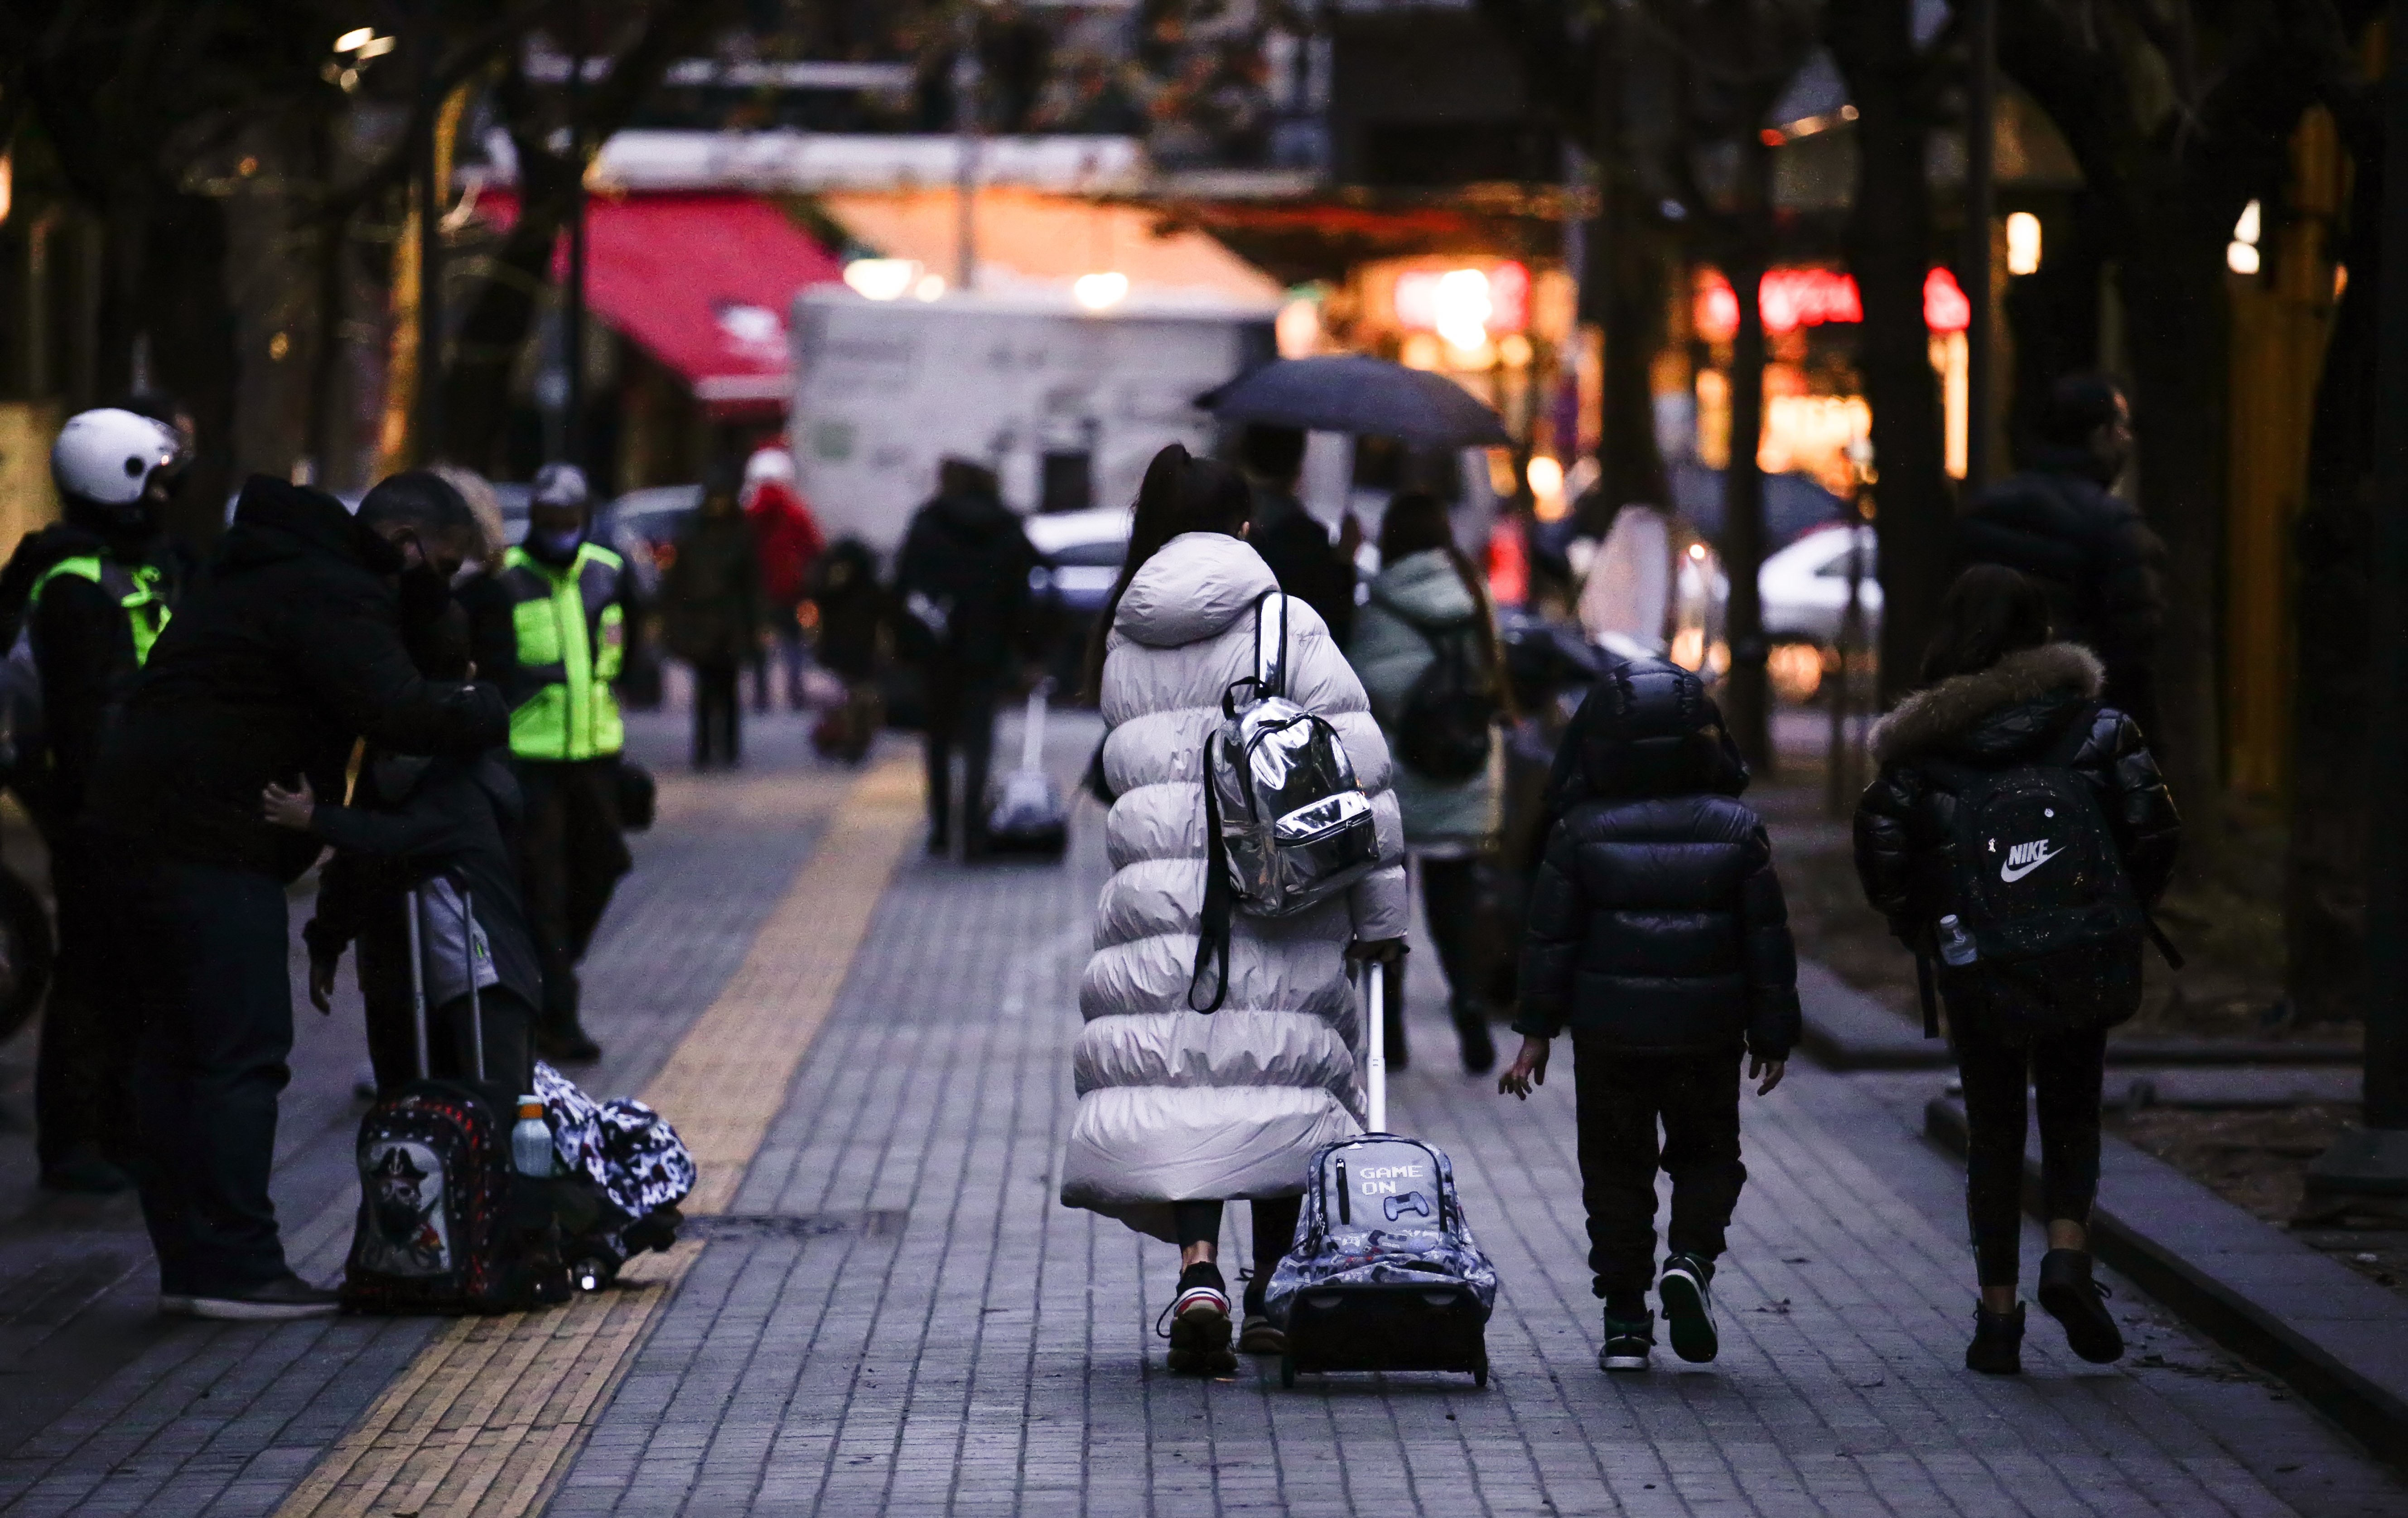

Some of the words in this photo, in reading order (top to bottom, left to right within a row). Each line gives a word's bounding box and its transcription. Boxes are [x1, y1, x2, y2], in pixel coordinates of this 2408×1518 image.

[2008, 839, 2049, 865] NIKE
[1360, 1165, 1424, 1179] GAME
[1362, 1181, 1396, 1195] ON
